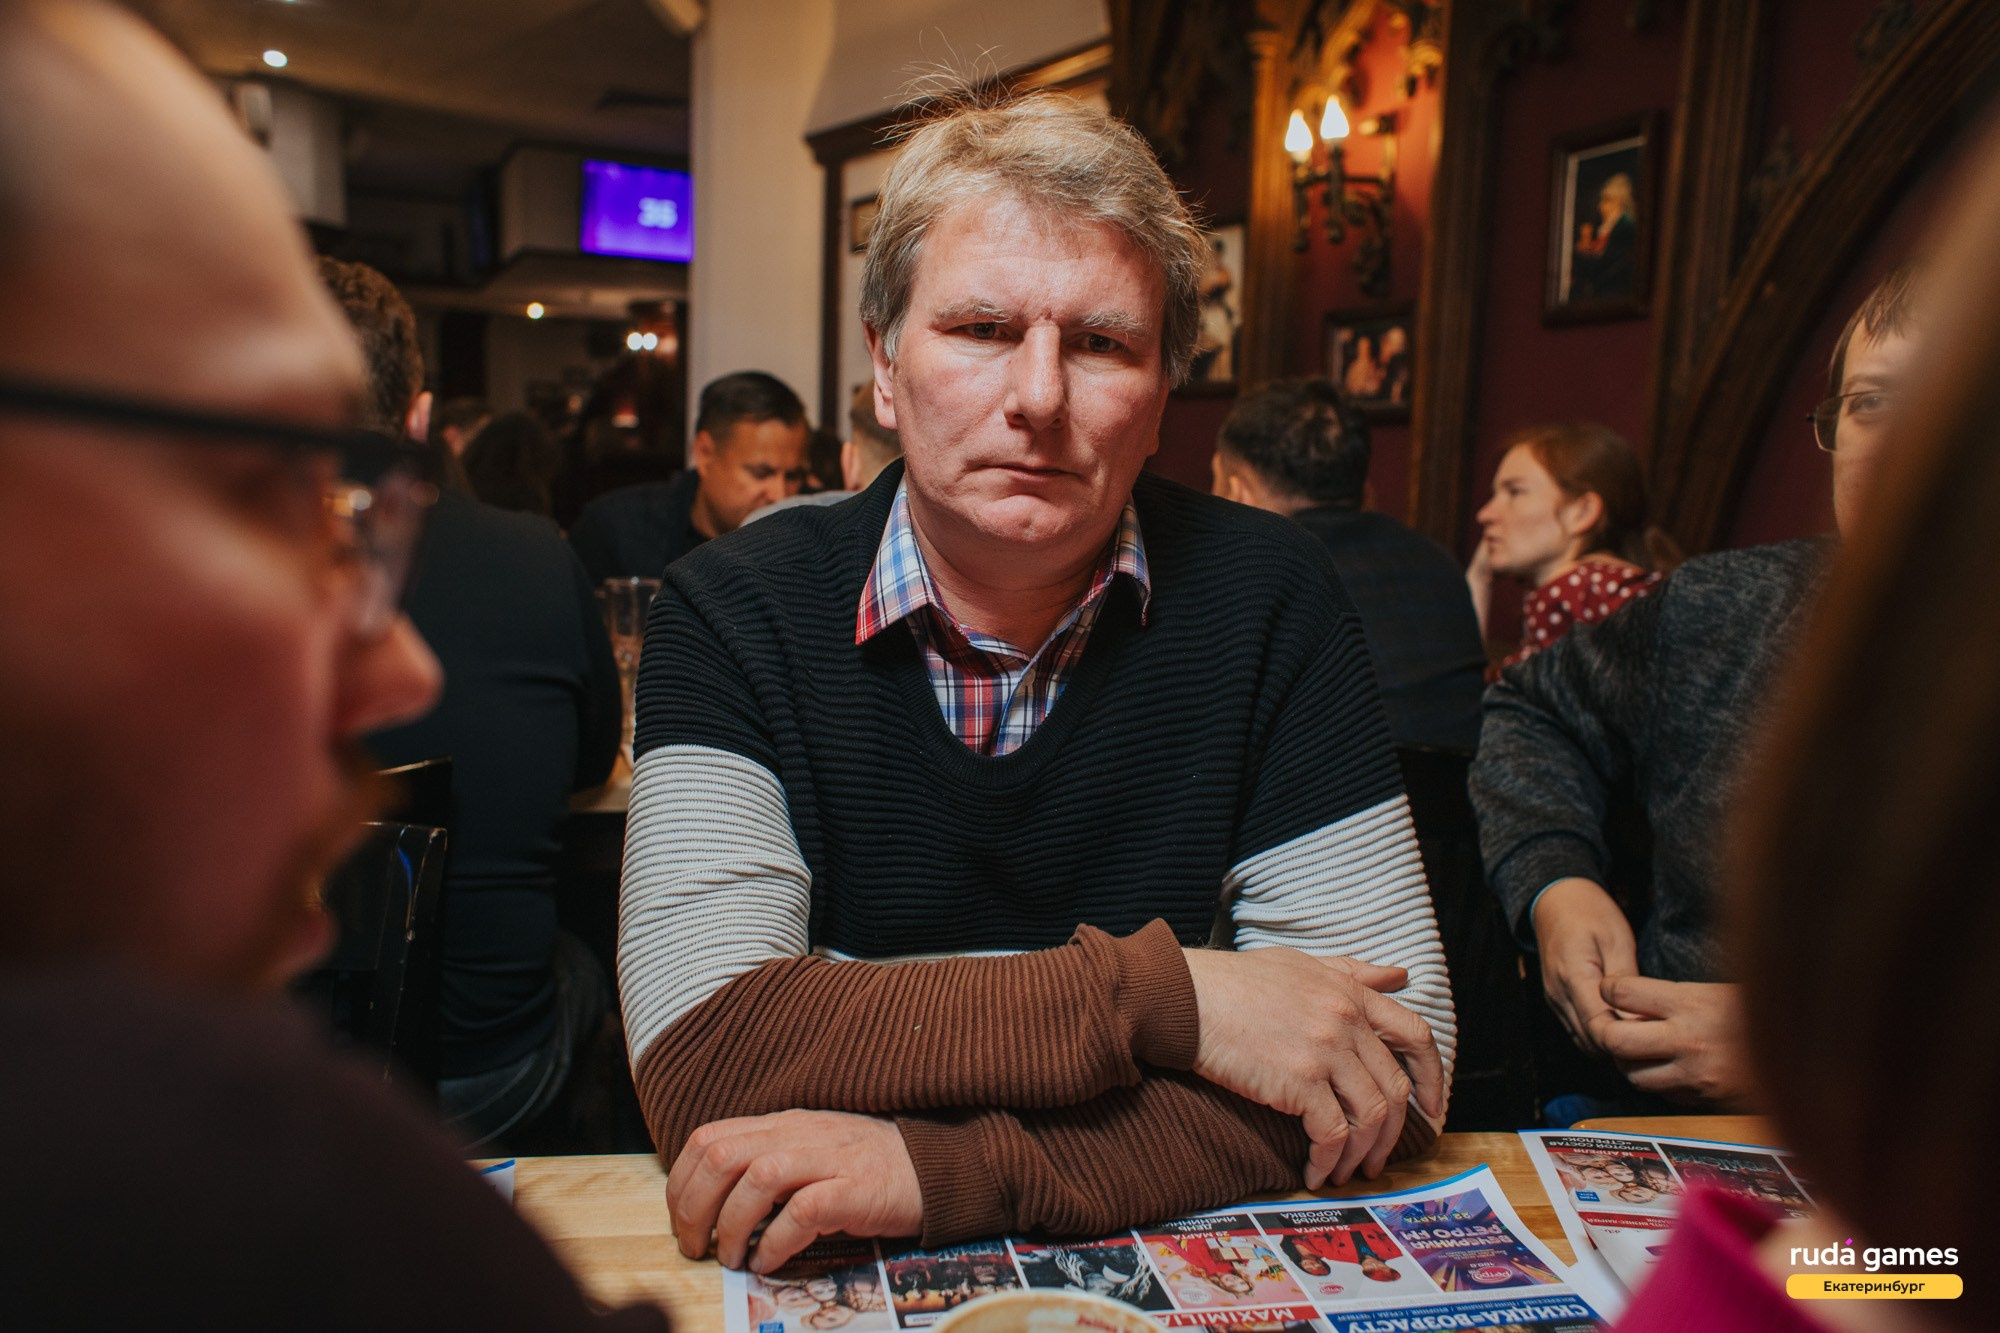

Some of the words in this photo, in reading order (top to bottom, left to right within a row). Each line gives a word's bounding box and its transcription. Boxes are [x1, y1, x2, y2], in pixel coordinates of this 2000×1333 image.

[1573, 1148, 1619, 1156] АПРЕЛЯ
[1280, 1209, 1342, 1219] КОРОВКА
[1403, 1214, 1448, 1224] МАРТА
[1292, 1215, 1339, 1225] БОЖЬЯ
[1178, 1223, 1212, 1232] ДЕНЬ
[1293, 1225, 1334, 1234] МАРТА
[1432, 1223, 1504, 1241] РЕТРО
[1172, 1232, 1213, 1240] МАРТА
[1399, 1229, 1431, 1241] FM
[1408, 1234, 1514, 1251] ВЕЧЕРИНКА
[1377, 1310, 1404, 1318] СРЕДА
[1411, 1306, 1449, 1316] ВТОРНИК
[1336, 1313, 1371, 1321] ЧЕТВЕРГ
